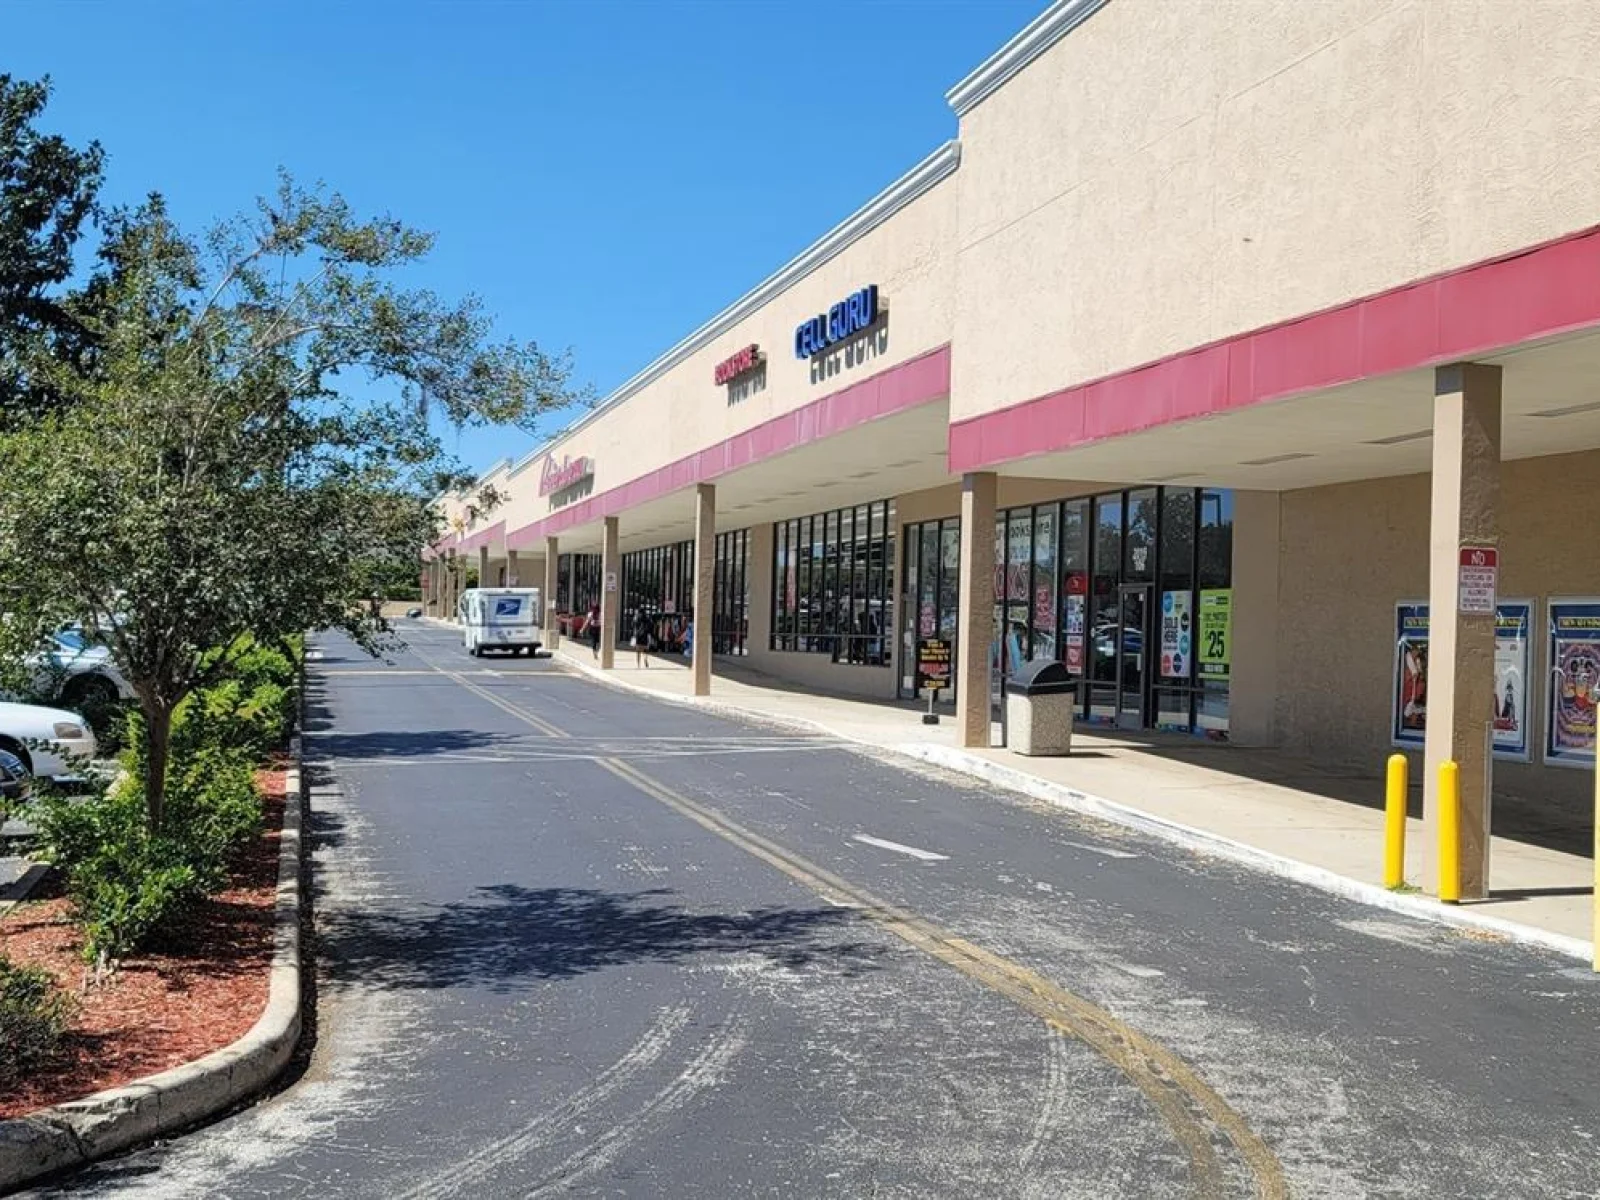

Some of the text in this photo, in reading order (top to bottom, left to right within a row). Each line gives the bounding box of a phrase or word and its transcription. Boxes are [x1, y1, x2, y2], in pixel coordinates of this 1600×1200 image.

[795, 285, 878, 360] CELL GURU
[1470, 552, 1486, 565] NO
